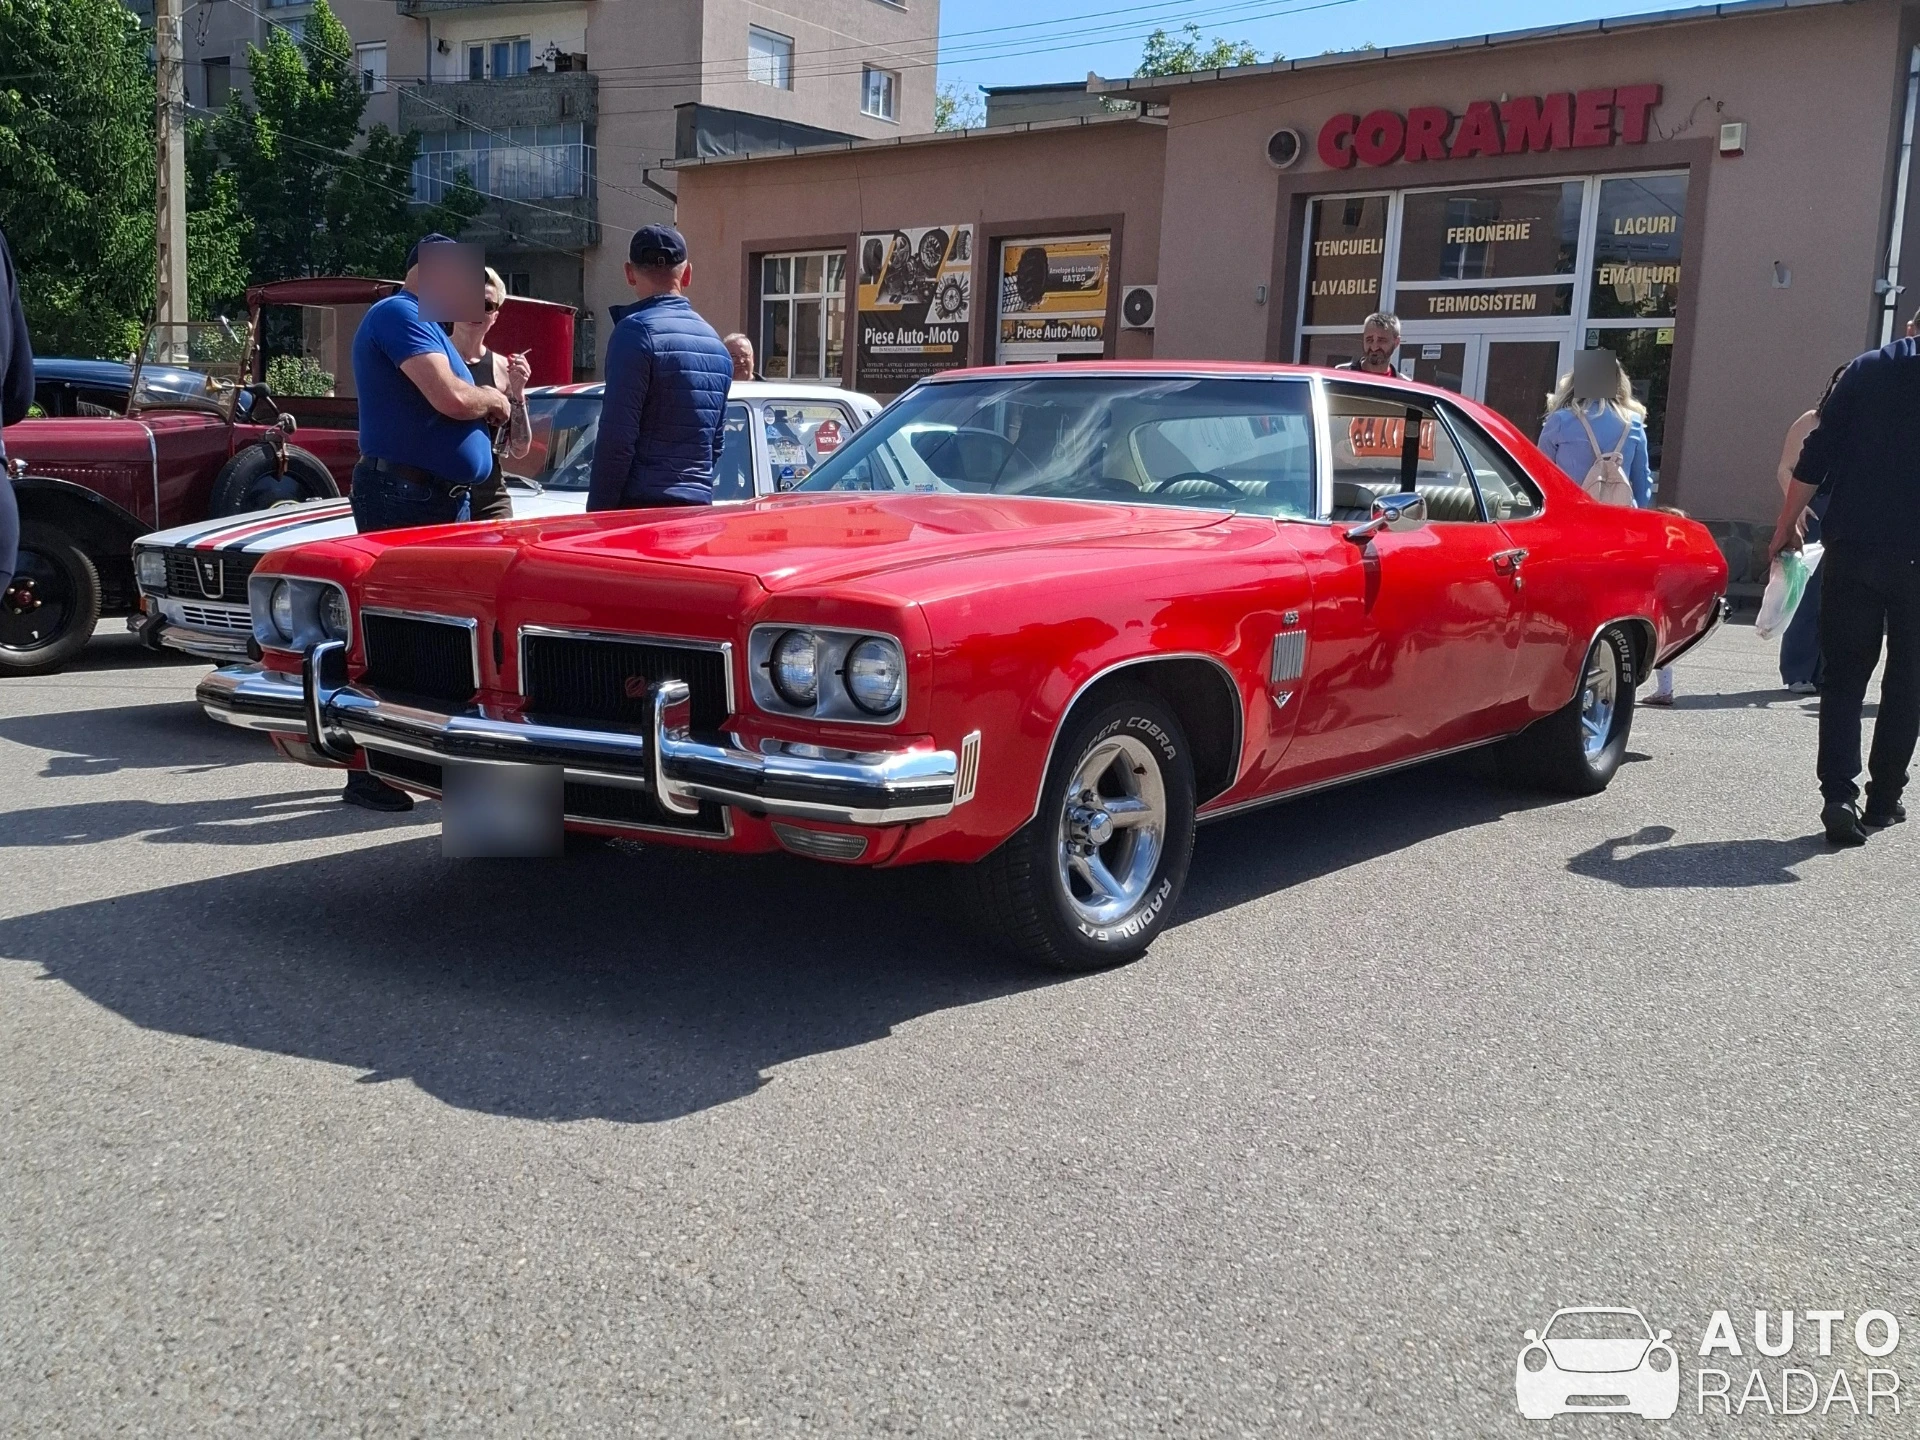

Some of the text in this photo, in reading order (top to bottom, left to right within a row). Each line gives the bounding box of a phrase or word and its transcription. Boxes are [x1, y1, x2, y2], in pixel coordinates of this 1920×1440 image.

[1317, 84, 1662, 169] CORAMET
[1447, 223, 1531, 244] FERONERIE
[1614, 216, 1677, 235] LACURI
[1314, 238, 1384, 257] TENCUIELI
[1598, 266, 1681, 285] EMAILURI
[1311, 278, 1378, 296] LAVABILE
[1428, 293, 1537, 313] TERMOSISTEM
[864, 326, 960, 345] Piese Auto-Moto
[1016, 323, 1098, 339] Piese Auto-Moto
[1126, 716, 1177, 760] COBRA
[1115, 878, 1172, 938] RADIAL
